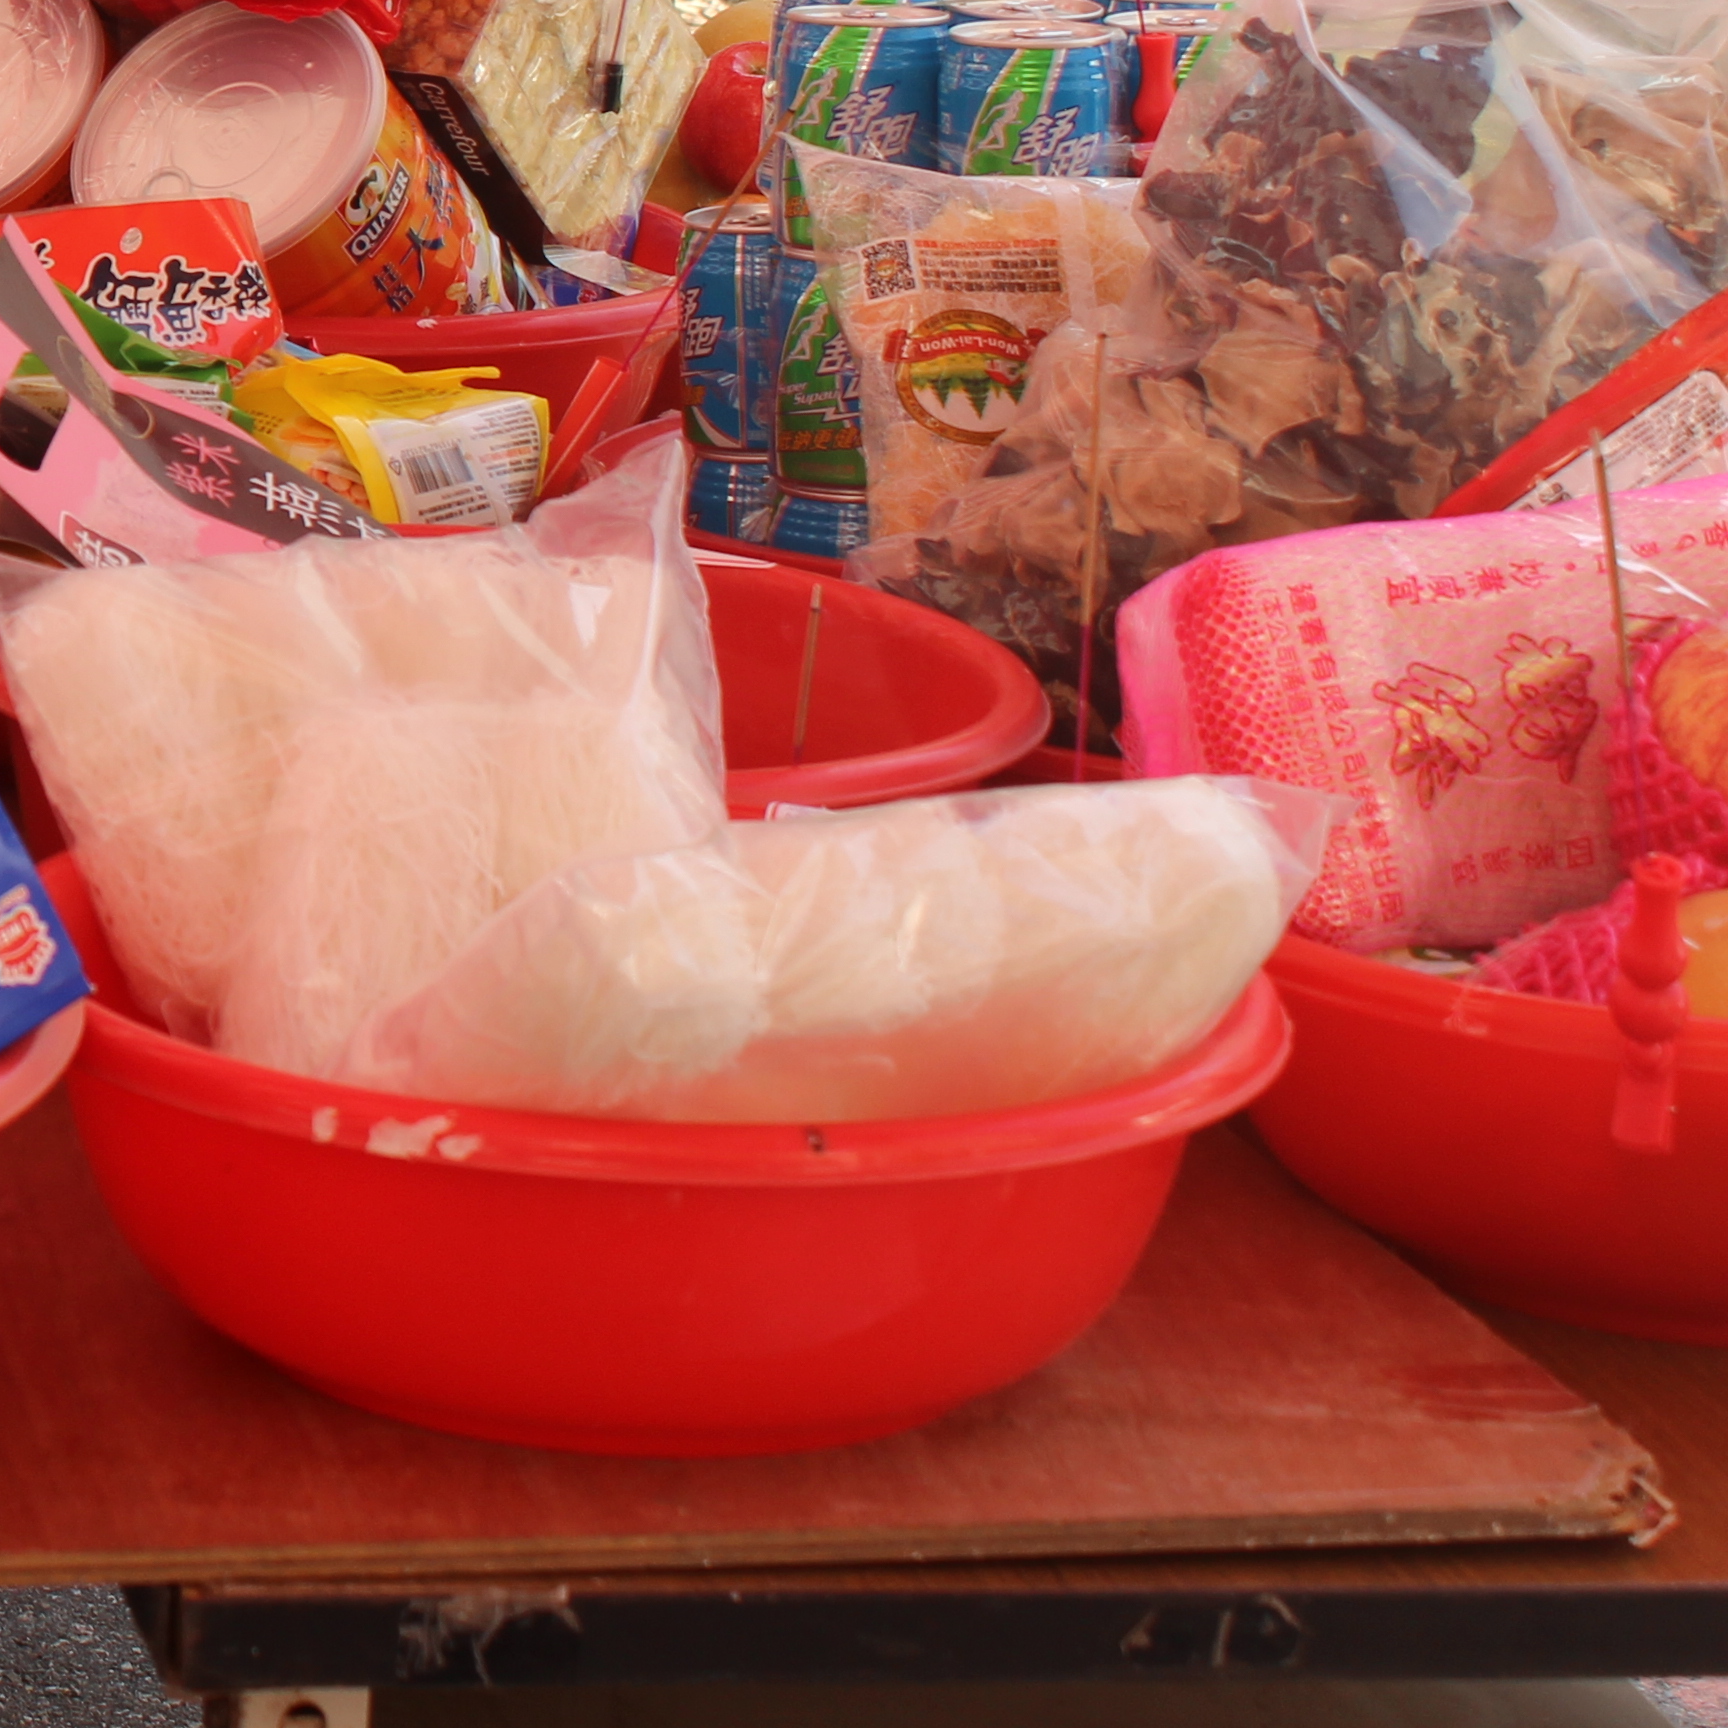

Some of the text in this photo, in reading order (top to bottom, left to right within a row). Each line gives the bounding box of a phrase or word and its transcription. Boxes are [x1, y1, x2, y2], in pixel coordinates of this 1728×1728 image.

[421, 76, 493, 178] Carrefour
[826, 85, 917, 163] 舒跑
[1012, 106, 1101, 177] 舒跑
[348, 173, 409, 257] QUAKER
[919, 333, 1022, 359] Won-Lai-Won
